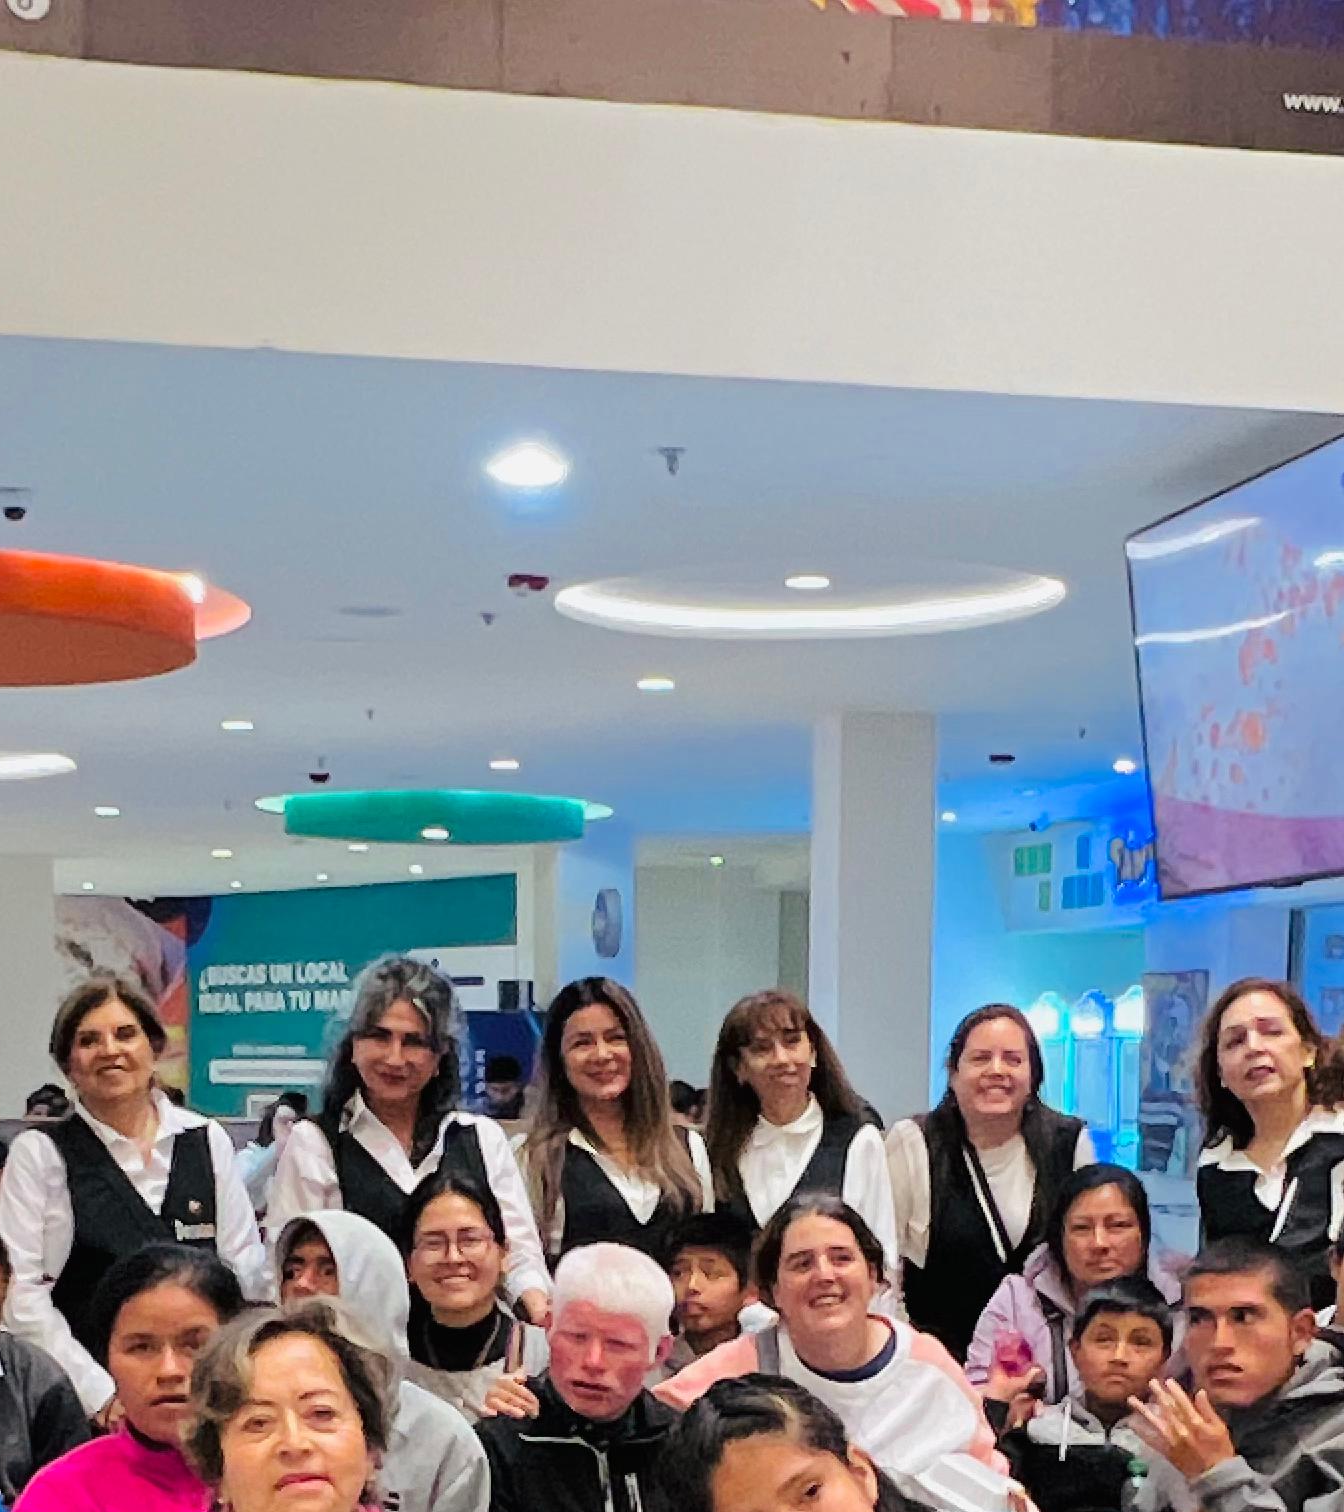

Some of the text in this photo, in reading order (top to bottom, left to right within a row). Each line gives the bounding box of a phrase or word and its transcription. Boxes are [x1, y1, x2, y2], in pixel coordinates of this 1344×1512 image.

[269, 962, 293, 986] UN
[295, 960, 350, 985] LOCAL
[244, 990, 287, 1013] PARA
[288, 990, 312, 1012] TU
